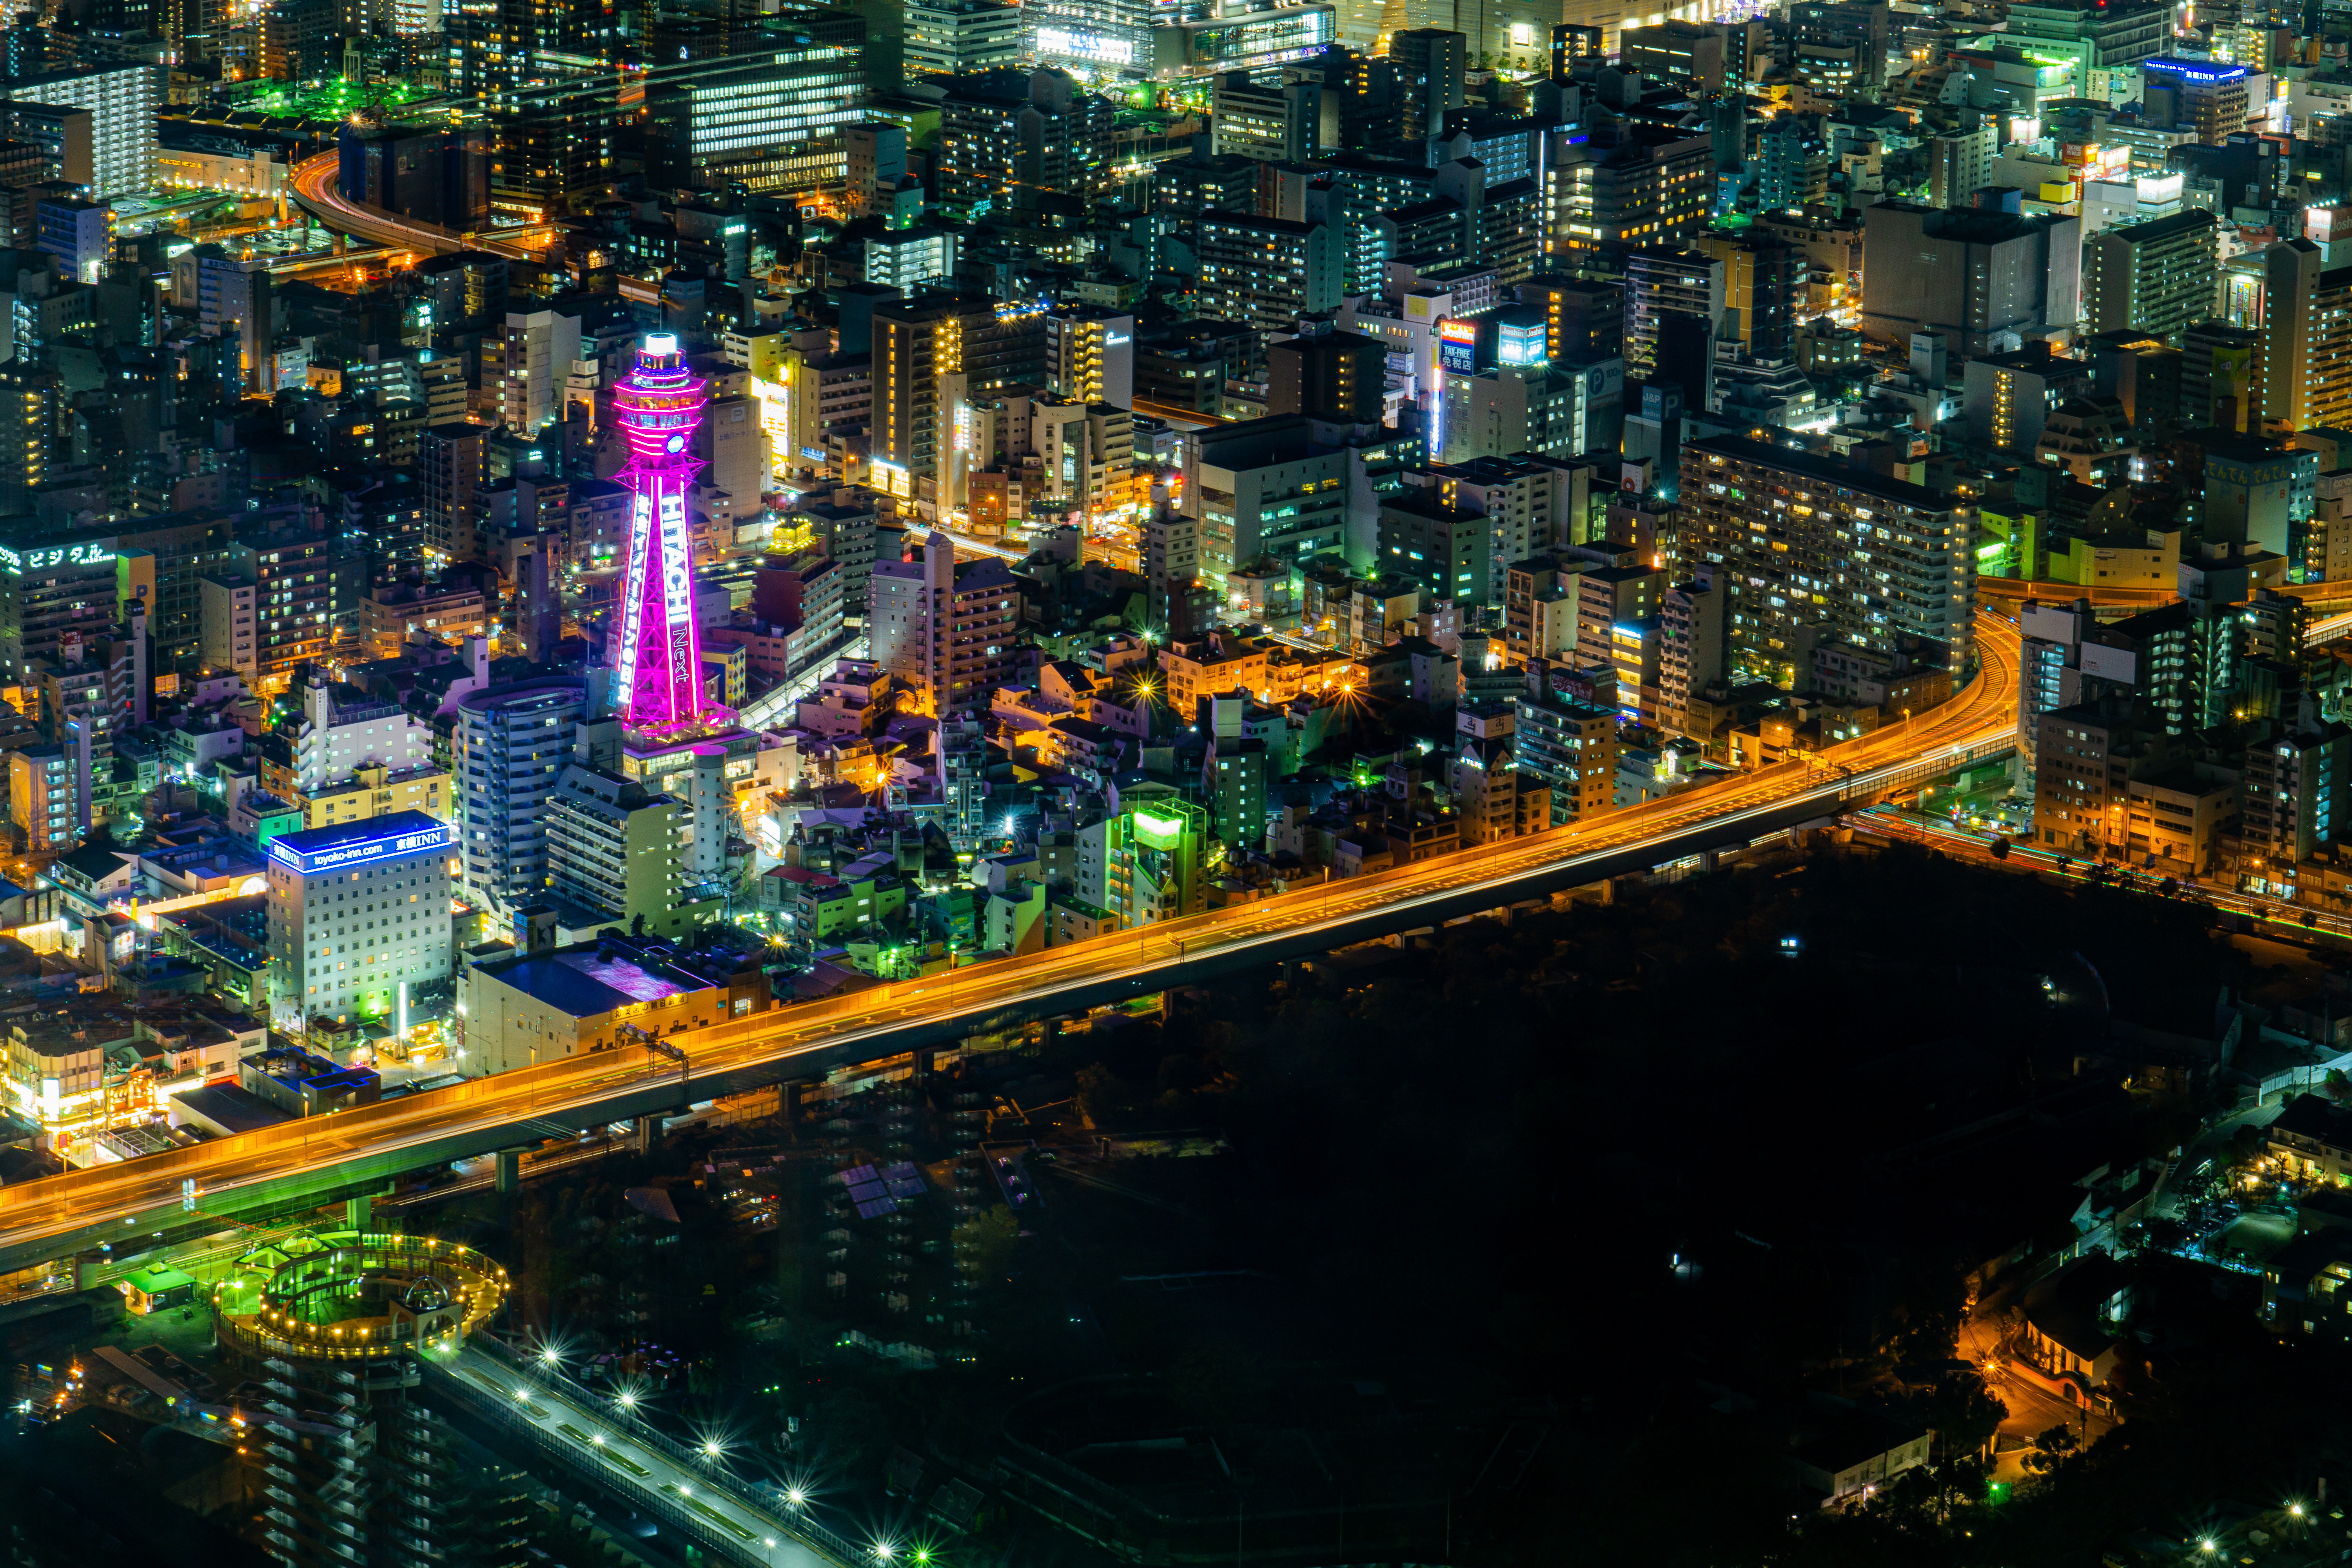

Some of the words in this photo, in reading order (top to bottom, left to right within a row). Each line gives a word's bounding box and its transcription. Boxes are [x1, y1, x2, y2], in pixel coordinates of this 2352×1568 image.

[2110, 166, 2123, 175] Joshin
[2139, 190, 2157, 200] PIER
[2308, 220, 2330, 229] Joshin
[1442, 324, 1473, 341] Joshin
[1502, 328, 1524, 337] Joshin
[1527, 328, 1544, 337] Joshin
[1445, 346, 1471, 358] TAX-FREE
[1502, 343, 1523, 354] J&P
[1527, 343, 1543, 356] J&P
[1443, 356, 1471, 371] 免税店
[1643, 393, 1661, 403] J&P
[1642, 409, 1661, 418] Joshin
[1665, 394, 1678, 418] P
[2207, 463, 2247, 484] てんでん
[2254, 465, 2288, 483] てんでん
[31, 544, 103, 568] ビジタル
[80, 554, 116, 564] MASUZAWA
[661, 495, 688, 624] HITACHI
[137, 584, 148, 599] P
[618, 495, 650, 703] 社会イノベーションの日立
[673, 626, 689, 683] Next
[396, 832, 441, 851] 東横INN
[314, 845, 383, 866] toyoko-inn.com
